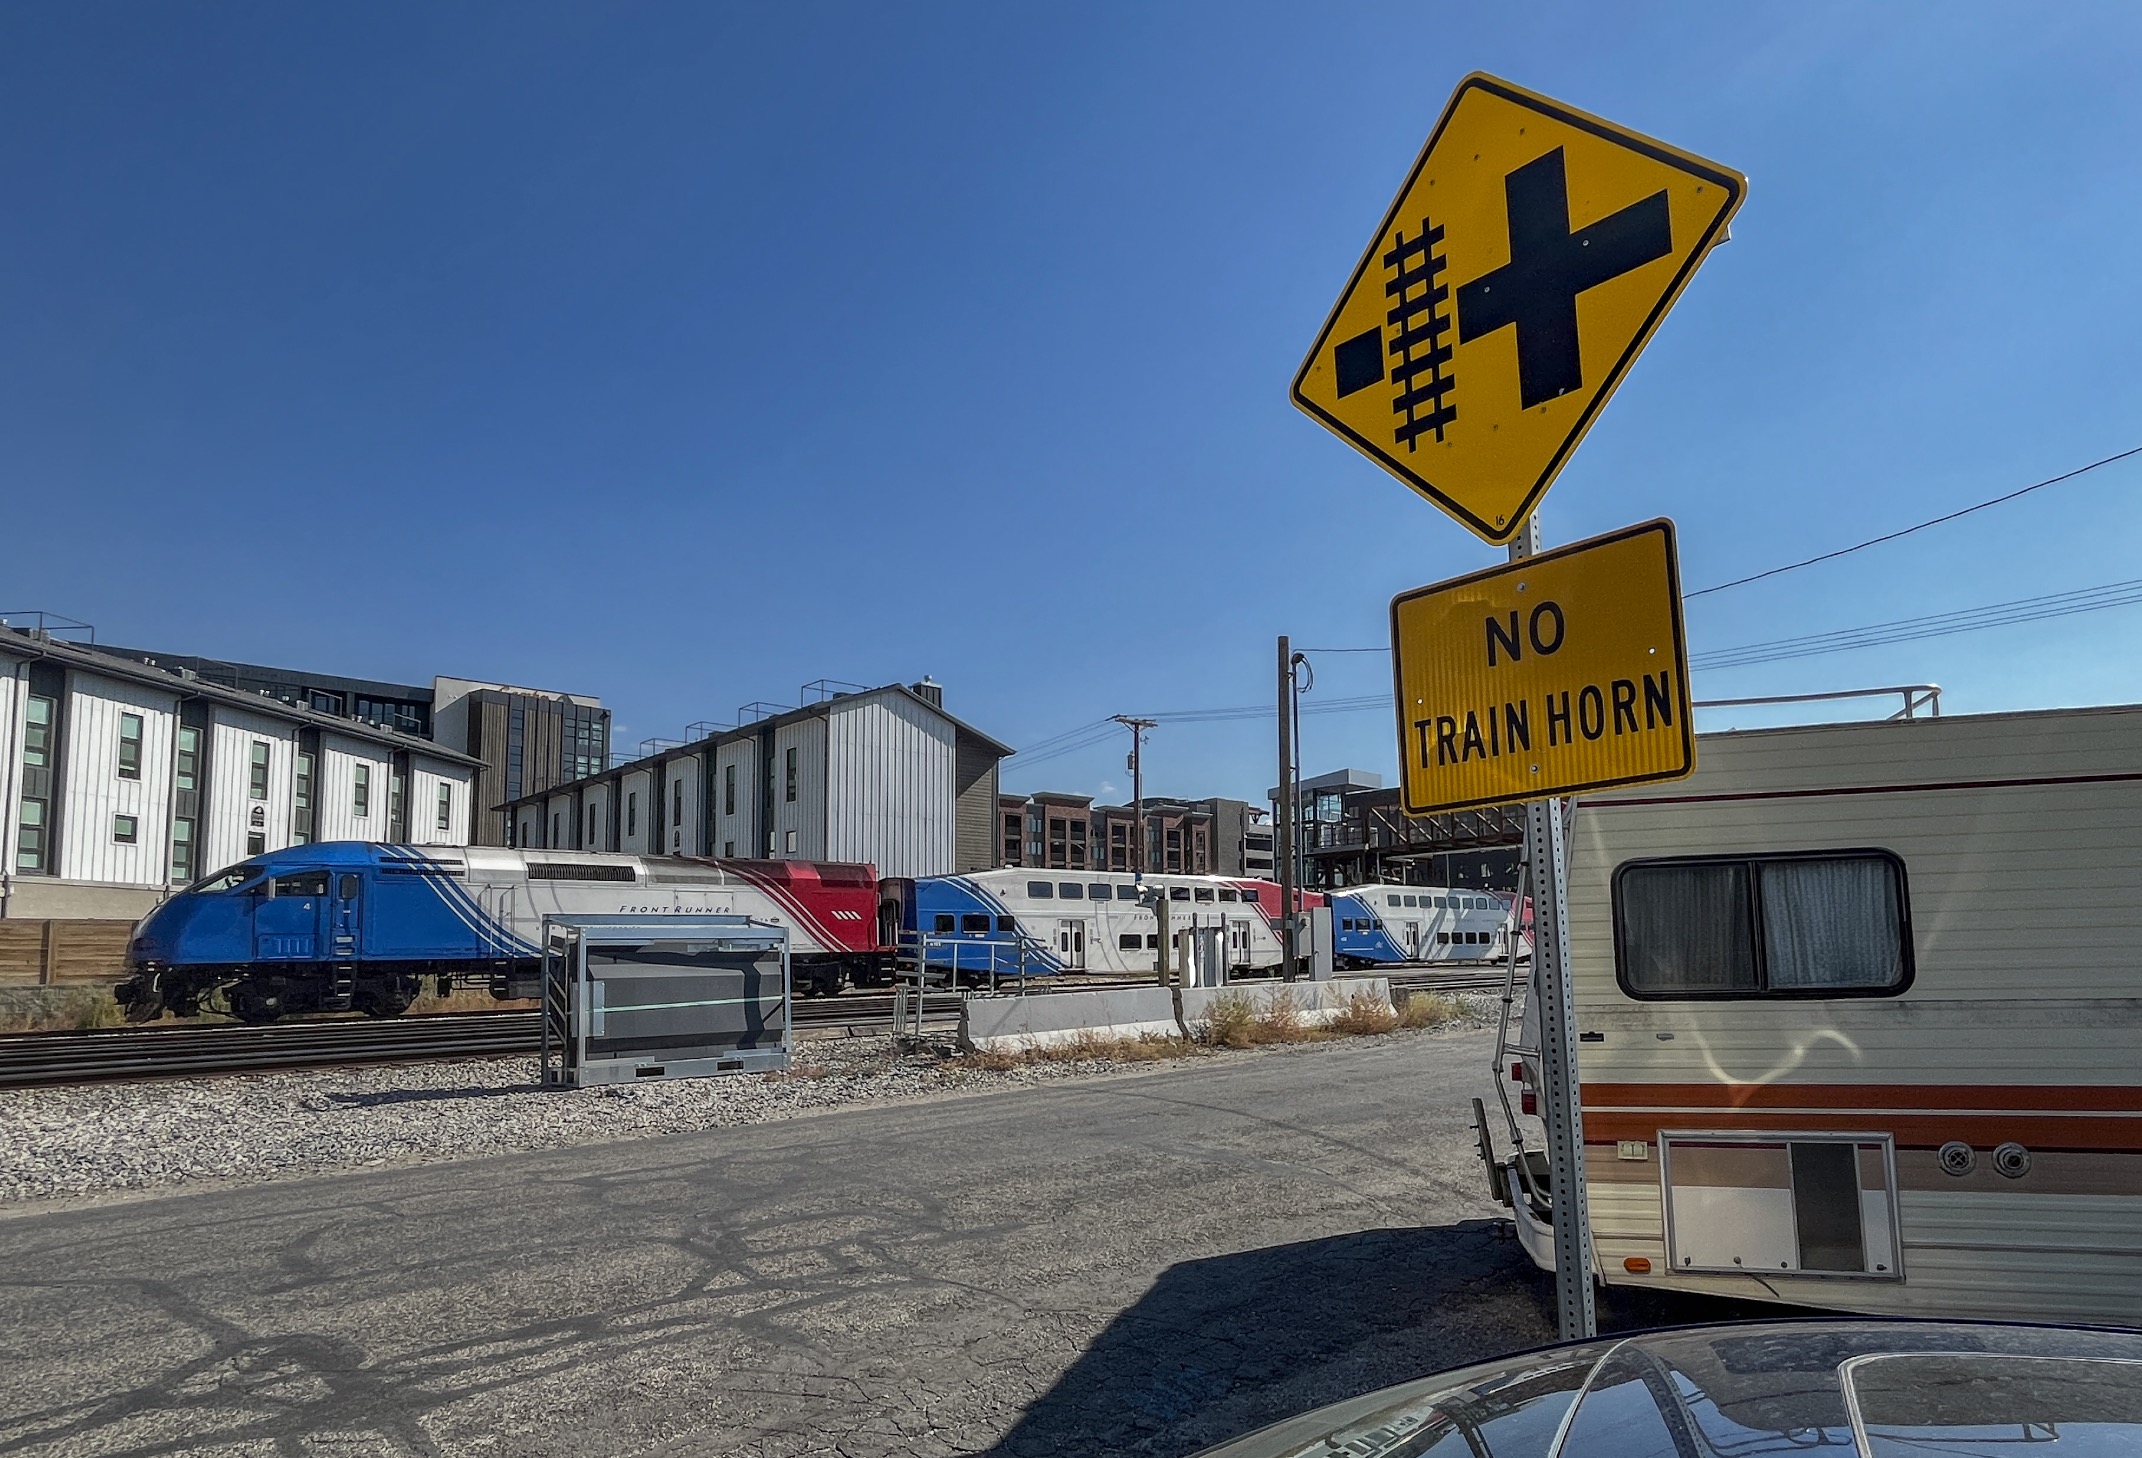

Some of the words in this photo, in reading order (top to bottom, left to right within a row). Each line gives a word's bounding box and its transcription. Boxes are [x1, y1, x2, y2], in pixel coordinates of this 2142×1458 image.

[1495, 514, 1505, 526] 16
[1485, 601, 1564, 667] NO
[1414, 699, 1530, 769] TRAIN
[1546, 670, 1672, 747] HORN
[303, 902, 311, 910] 4
[619, 905, 669, 913] FRONT
[674, 905, 730, 913] RUNNER
